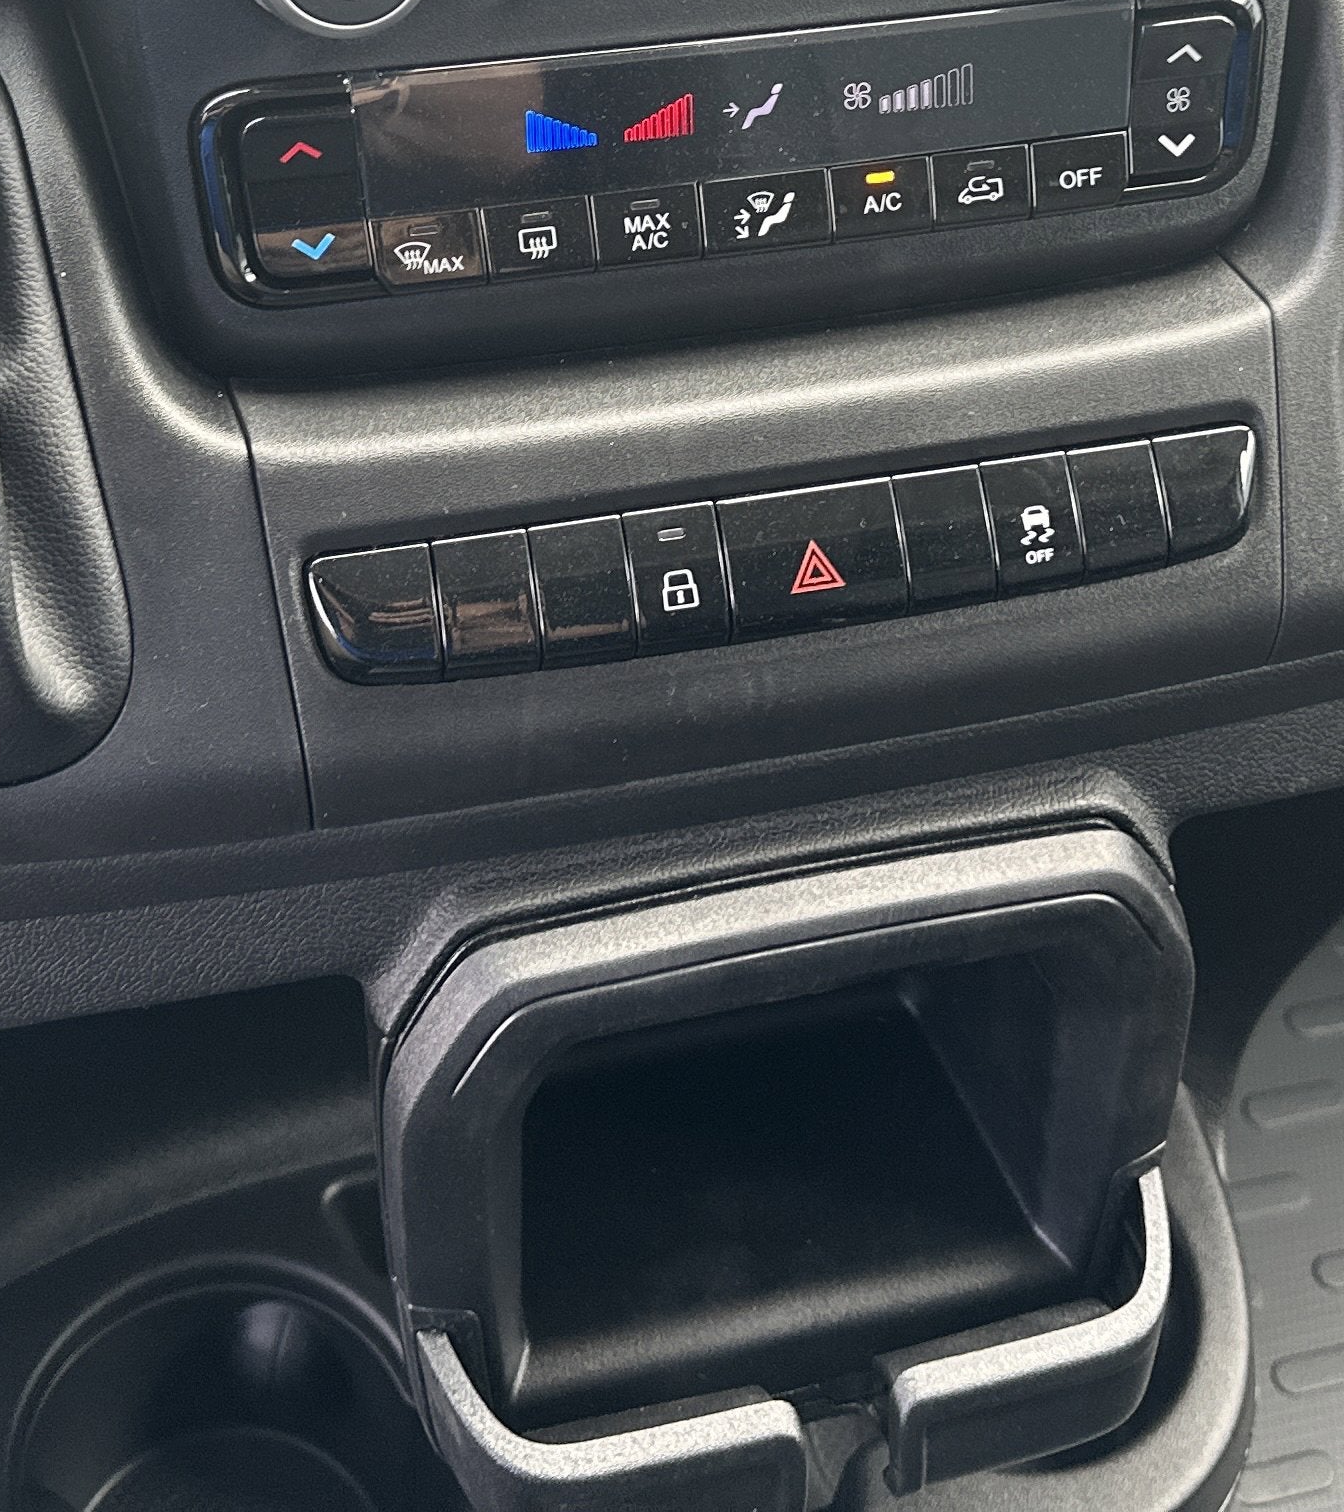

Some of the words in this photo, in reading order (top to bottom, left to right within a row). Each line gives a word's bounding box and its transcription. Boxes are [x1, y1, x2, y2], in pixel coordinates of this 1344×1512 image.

[1058, 167, 1103, 190] OFF
[863, 191, 903, 215] A/C
[623, 212, 672, 235] MAX
[631, 231, 669, 252] A/C
[423, 255, 465, 275] MAX
[1025, 547, 1054, 565] OFF
